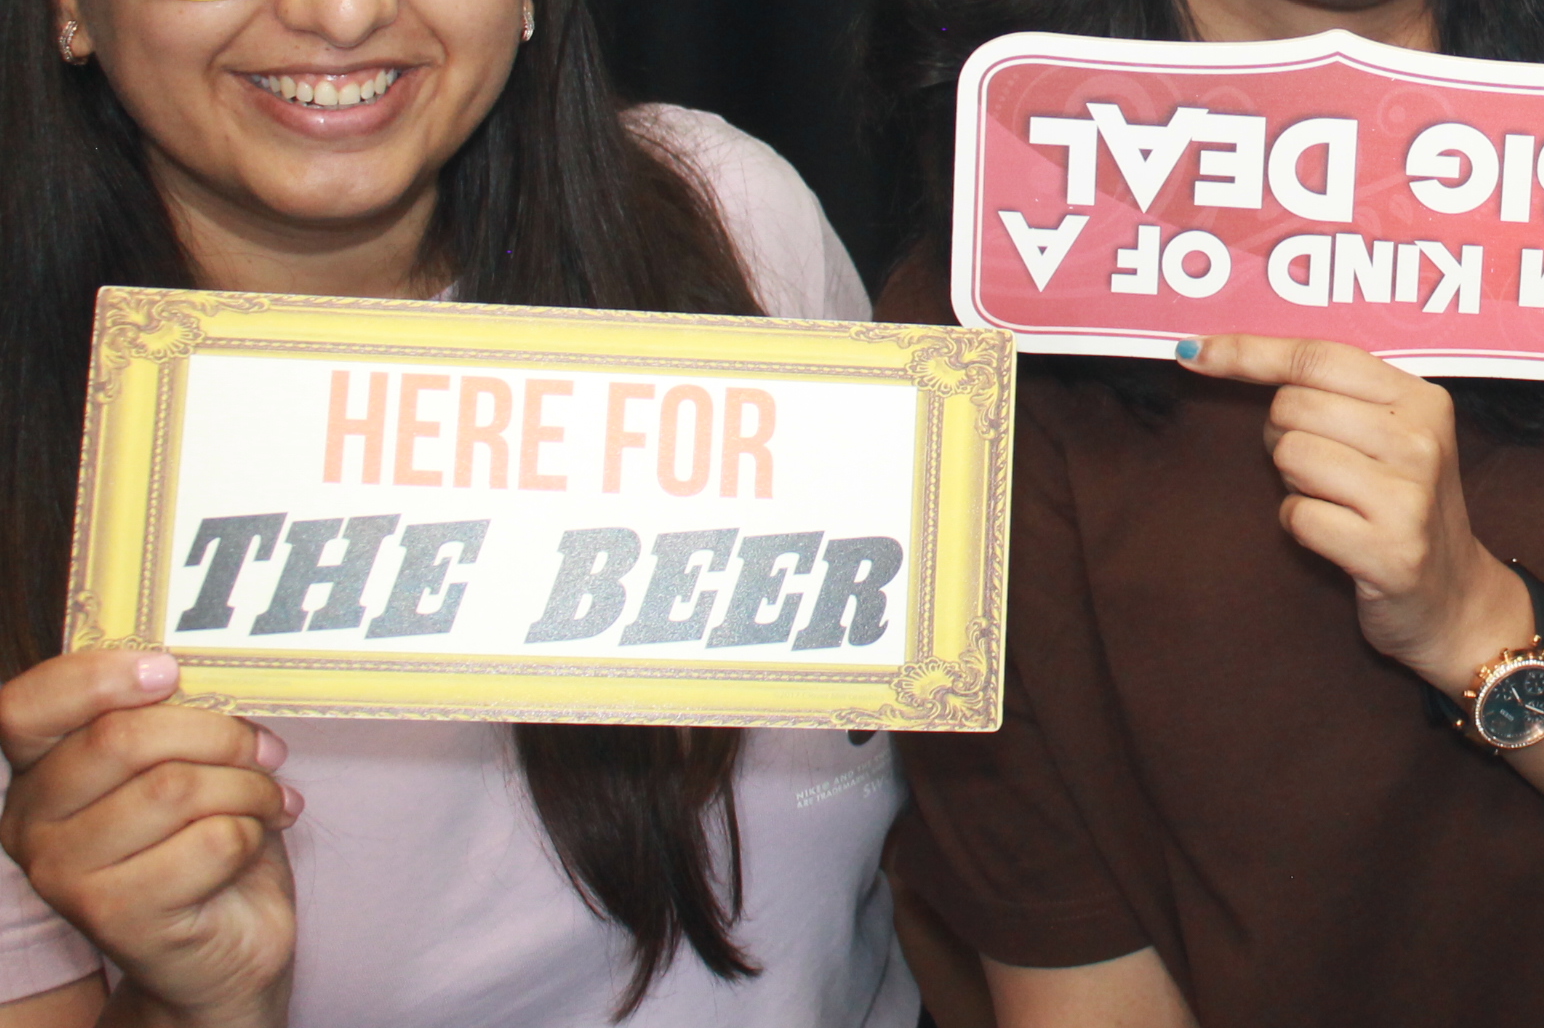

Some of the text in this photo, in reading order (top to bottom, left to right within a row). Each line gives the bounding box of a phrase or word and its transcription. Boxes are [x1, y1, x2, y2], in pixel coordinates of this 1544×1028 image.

[1029, 102, 1358, 222] DEAL
[998, 211, 1089, 292] A
[1110, 225, 1232, 299] OF
[1268, 234, 1483, 316] KIND
[322, 370, 778, 500] HERE FOR
[175, 512, 904, 652] THE BEER
